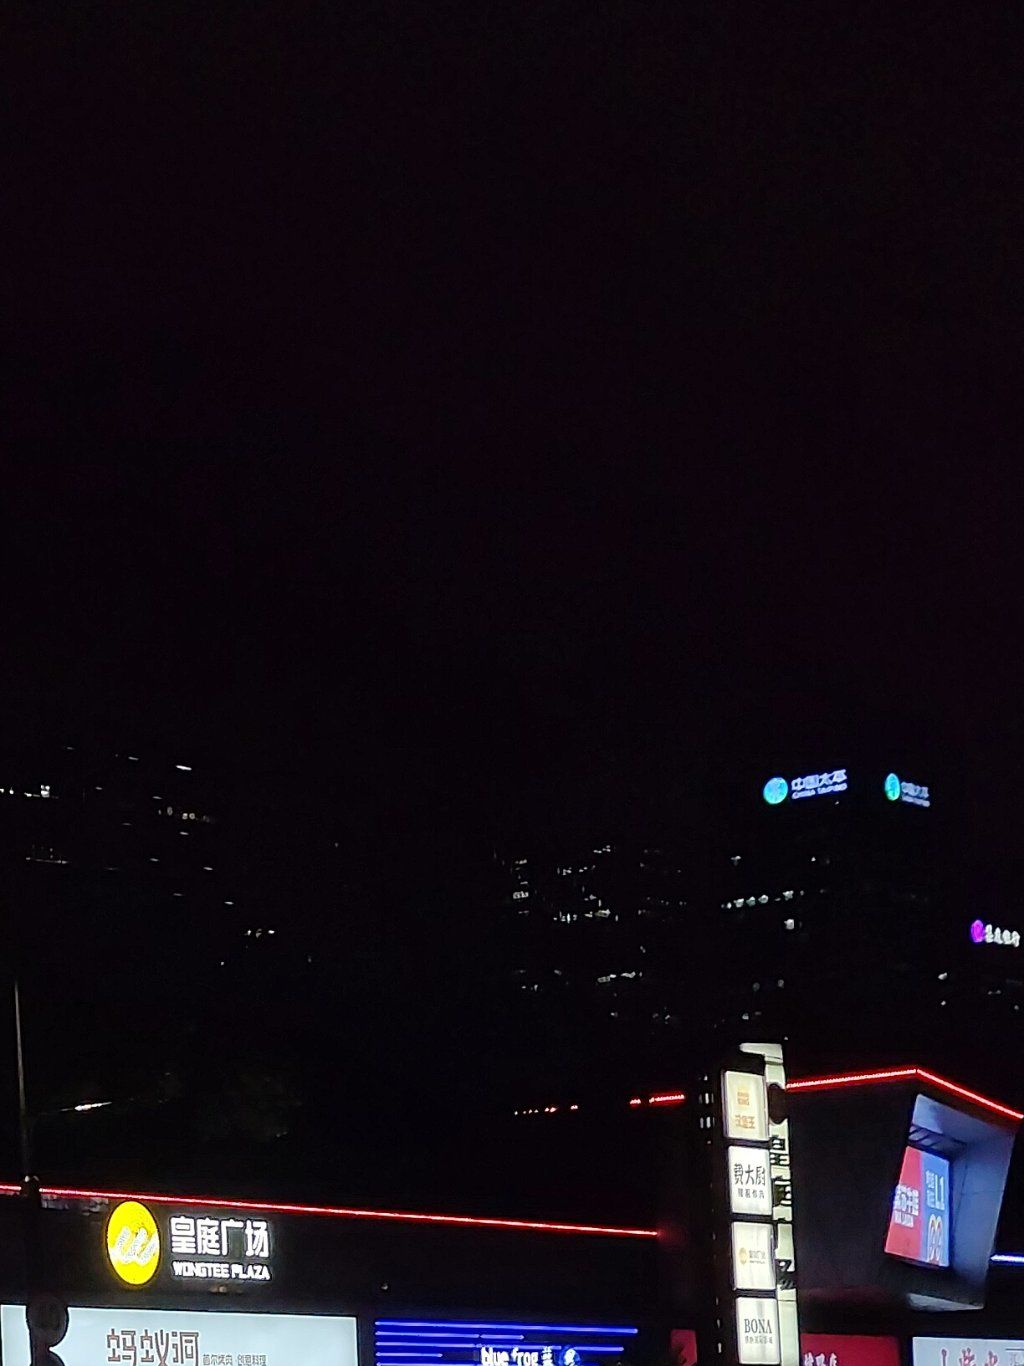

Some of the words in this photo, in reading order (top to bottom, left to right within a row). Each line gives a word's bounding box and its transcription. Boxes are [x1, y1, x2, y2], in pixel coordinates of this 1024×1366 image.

[170, 1215, 270, 1257] 皇庭广场
[173, 1261, 229, 1278] WONGTEE
[231, 1264, 270, 1280] PLAZA
[744, 1319, 773, 1334] BONA
[481, 1346, 509, 1366] blue
